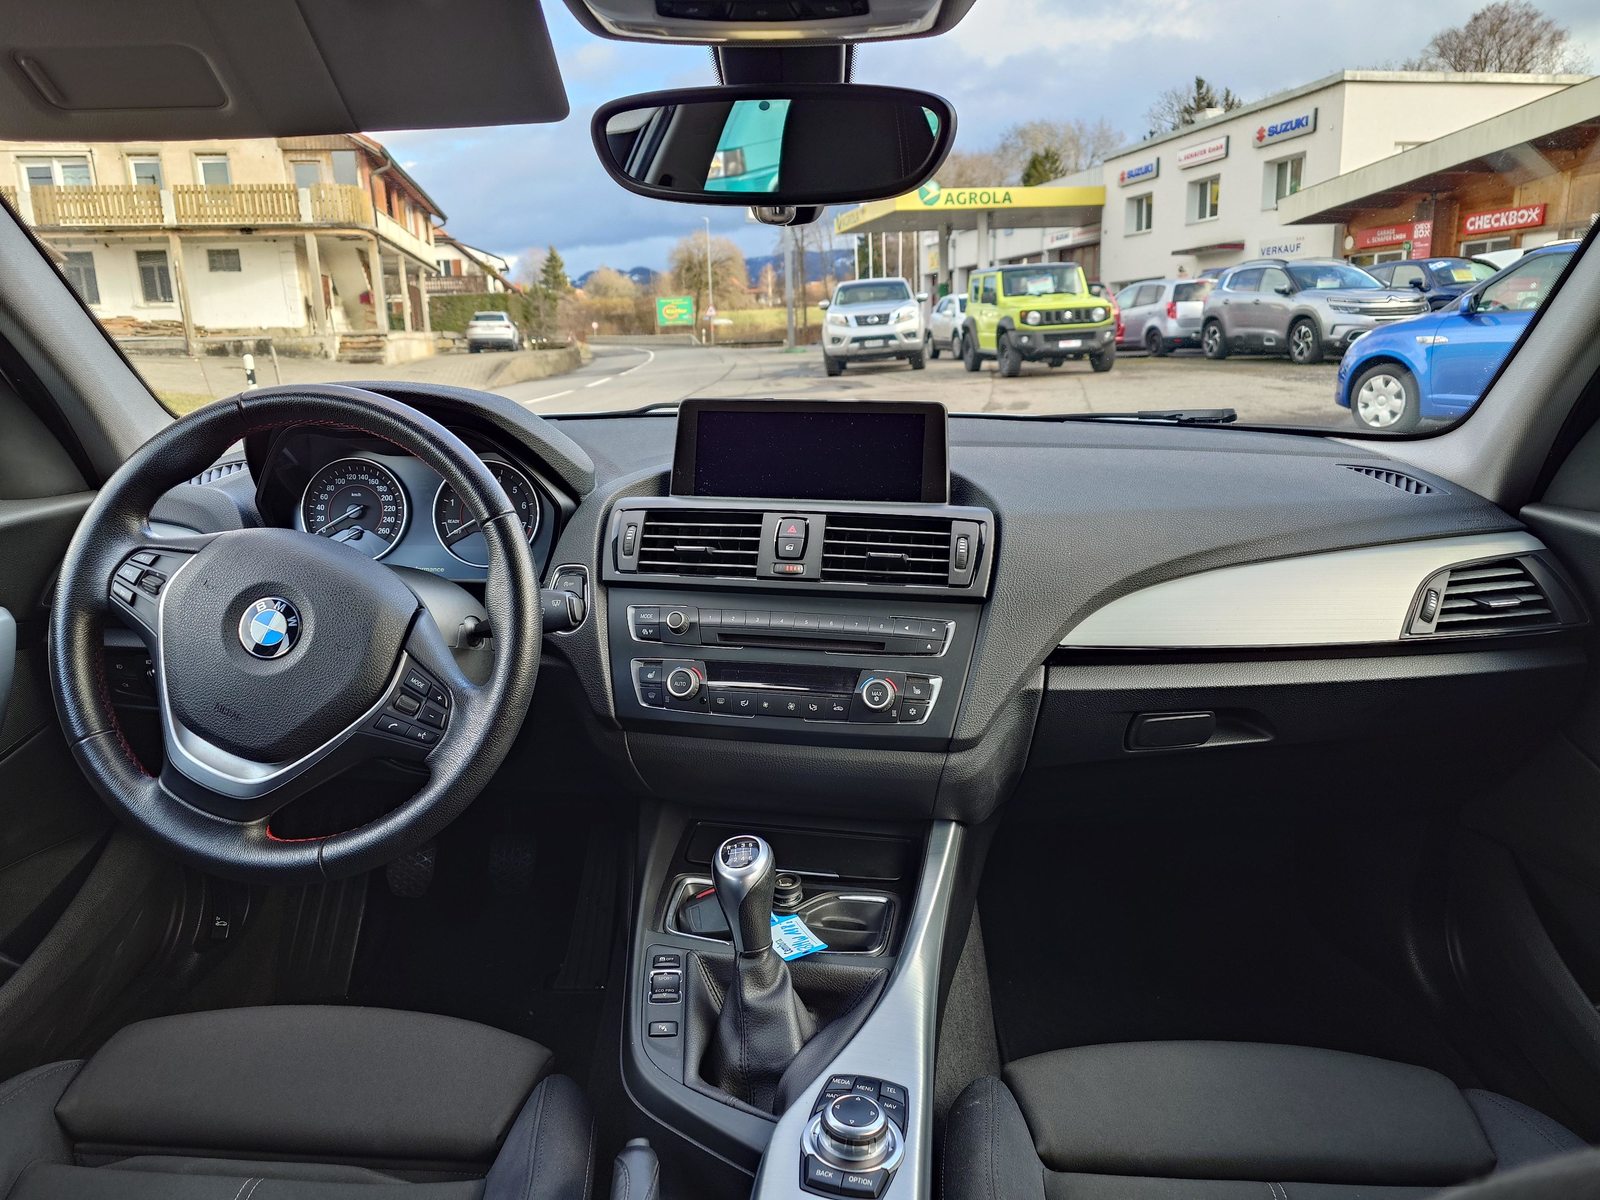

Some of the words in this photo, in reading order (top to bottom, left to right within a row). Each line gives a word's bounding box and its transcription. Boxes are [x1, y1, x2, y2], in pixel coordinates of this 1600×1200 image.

[1267, 115, 1309, 137] SUZUKI
[1127, 163, 1154, 178] SUZUKI
[944, 191, 1013, 206] AGROLA
[1466, 206, 1541, 231] CHECKBOX
[1413, 229, 1431, 239] BOX
[1260, 242, 1302, 256] VERKAUF
[326, 484, 335, 492] 80
[512, 486, 518, 494] 5
[450, 499, 455, 507] 1
[256, 600, 299, 628] BMW
[411, 677, 425, 689] MODE
[832, 1077, 851, 1086] MEDIA
[856, 1084, 874, 1092] MENU
[886, 1086, 897, 1094] TEL
[884, 1101, 897, 1109] NAV
[815, 1168, 834, 1178] BACK
[848, 1175, 873, 1186] OPTION
